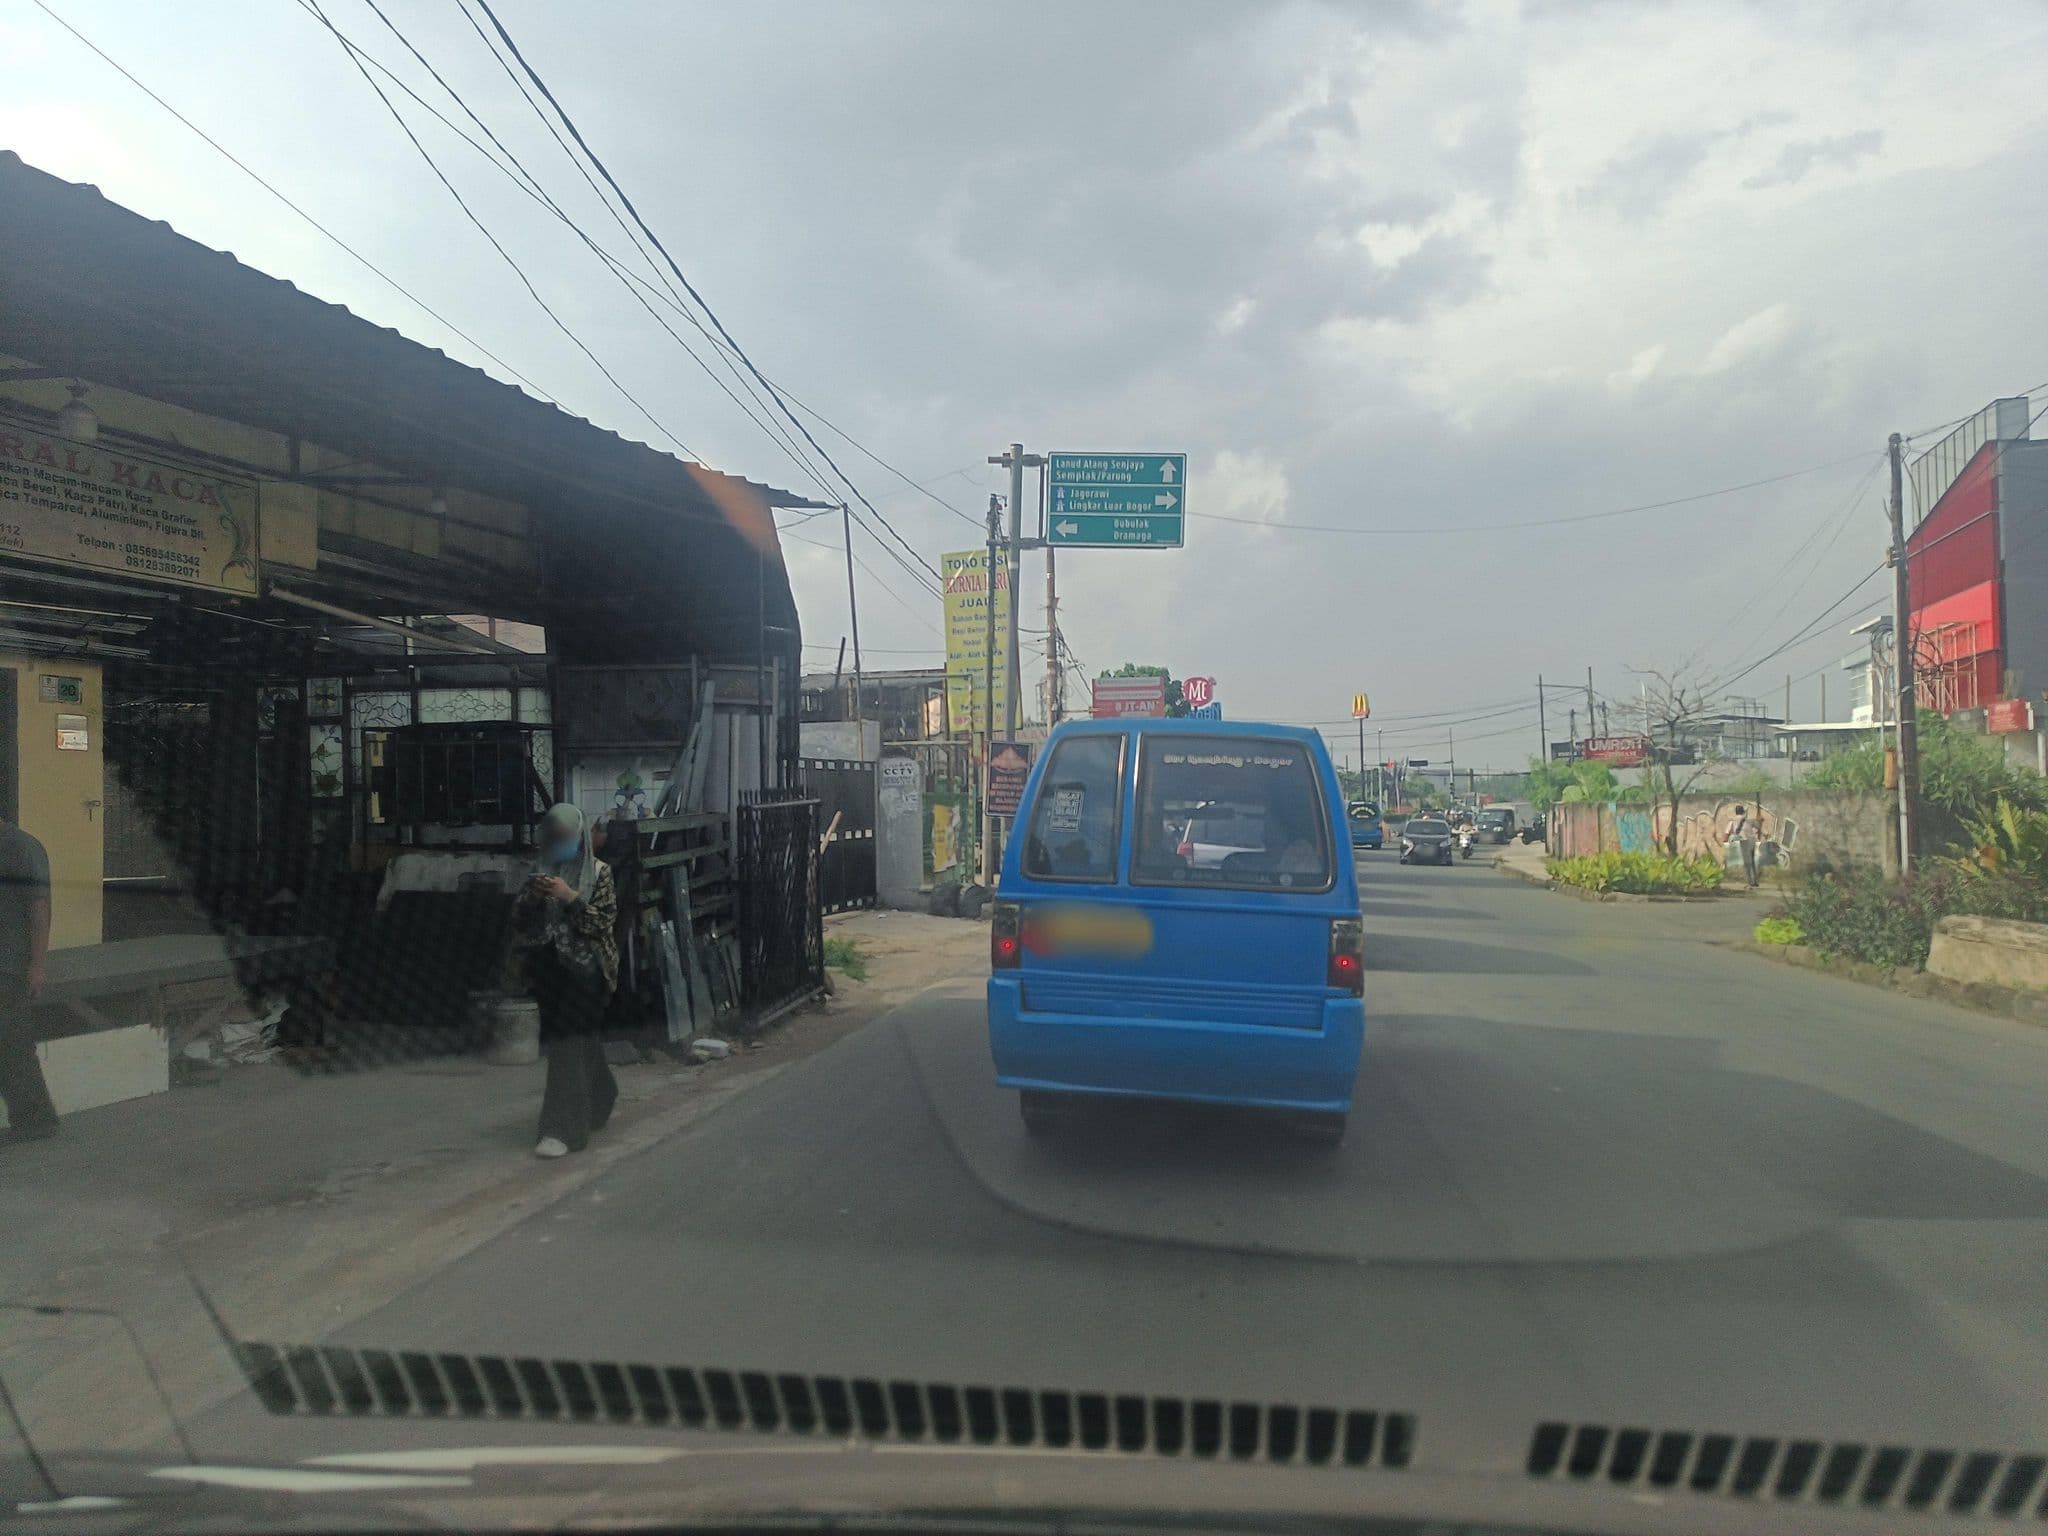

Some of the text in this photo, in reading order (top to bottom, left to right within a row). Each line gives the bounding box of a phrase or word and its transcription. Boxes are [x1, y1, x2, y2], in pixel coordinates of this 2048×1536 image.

[1056, 458, 1145, 472] Lanud Atang Senjaya
[111, 462, 219, 506] KACA
[125, 488, 153, 504] Kaca
[1070, 488, 1110, 500] Jagorawi
[64, 487, 95, 504] Kaca
[131, 502, 159, 517] Kaca
[1069, 500, 1151, 512] Lingkar Luar Bogor
[155, 520, 188, 535] Figura
[1113, 518, 1149, 528] Bubulak
[76, 533, 115, 550] Telpon
[1113, 530, 1152, 542] Dramaga
[946, 557, 977, 570] TOKO
